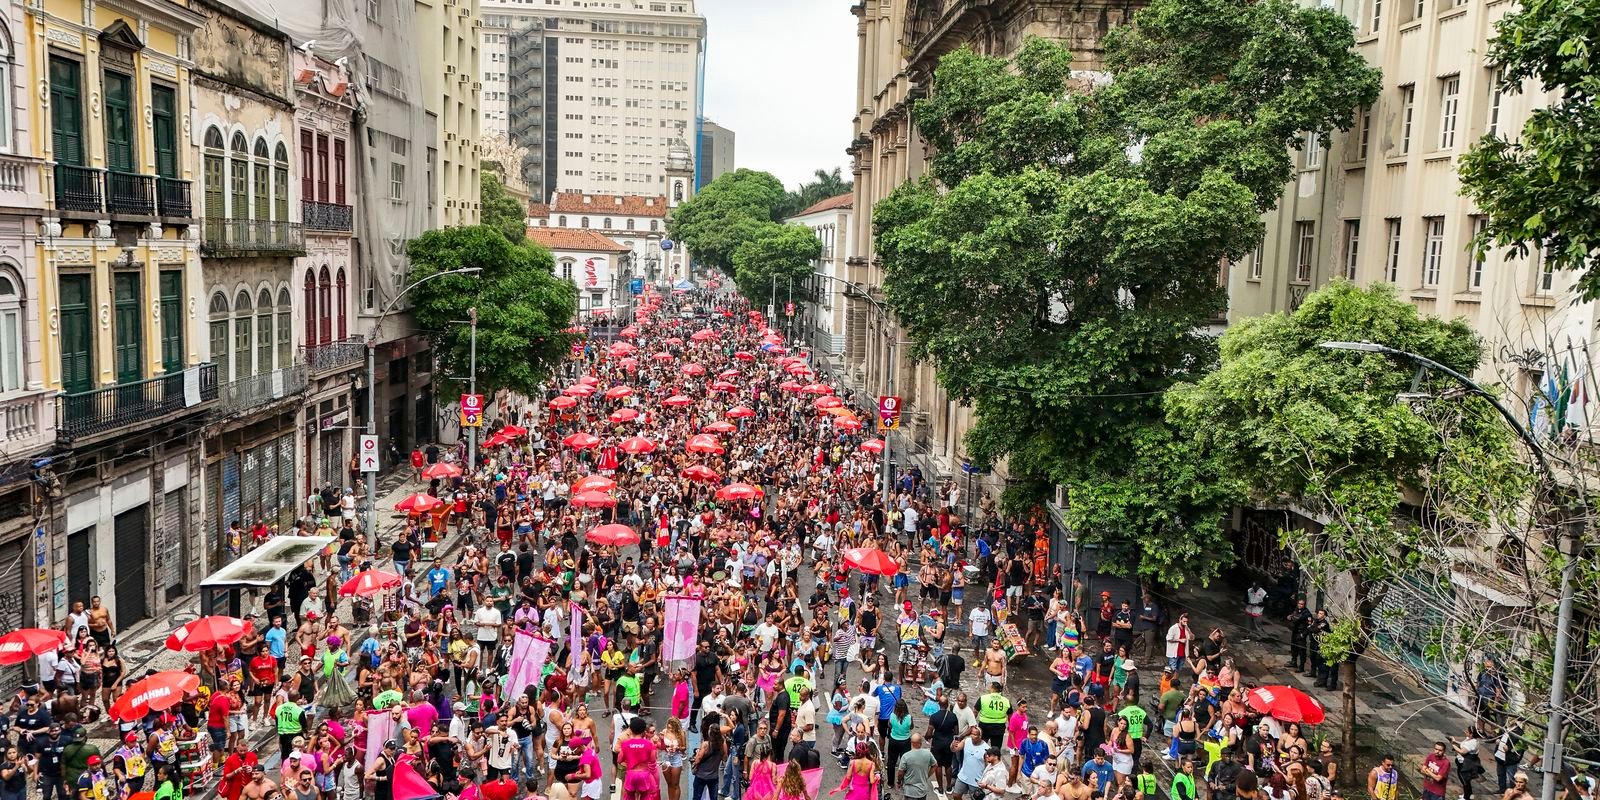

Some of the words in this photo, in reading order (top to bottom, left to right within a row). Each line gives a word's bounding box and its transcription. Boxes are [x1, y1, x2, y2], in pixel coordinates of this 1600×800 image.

[131, 686, 170, 708] BRAHMA
[988, 700, 1004, 711] 419
[280, 710, 293, 722] 170
[1130, 715, 1143, 725] 636
